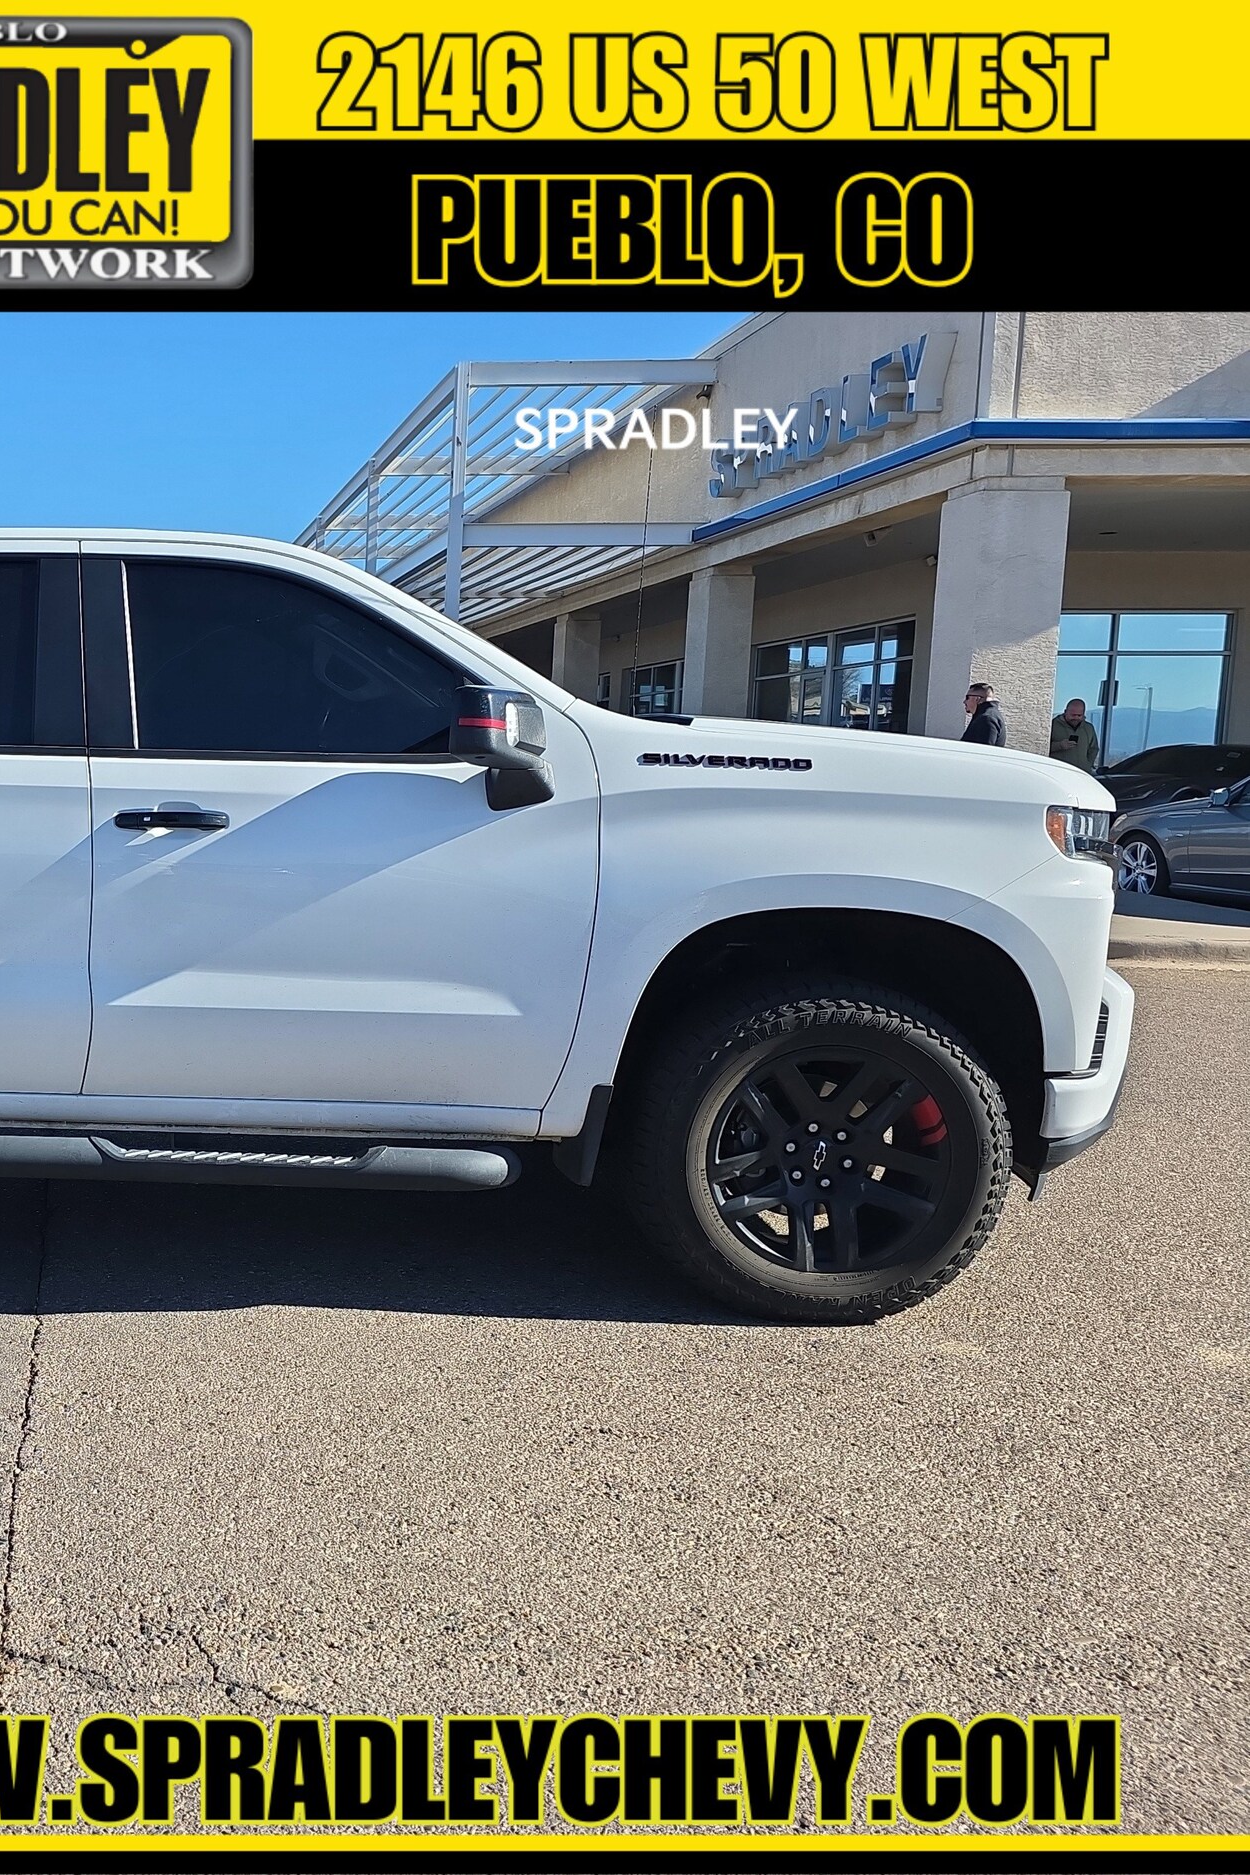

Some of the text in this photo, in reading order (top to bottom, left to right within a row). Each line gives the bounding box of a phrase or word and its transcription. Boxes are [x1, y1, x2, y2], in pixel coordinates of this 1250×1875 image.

[709, 332, 957, 498] SPRADLEY
[637, 753, 813, 771] SILVERADO
[799, 1009, 912, 1038] TERRAIN
